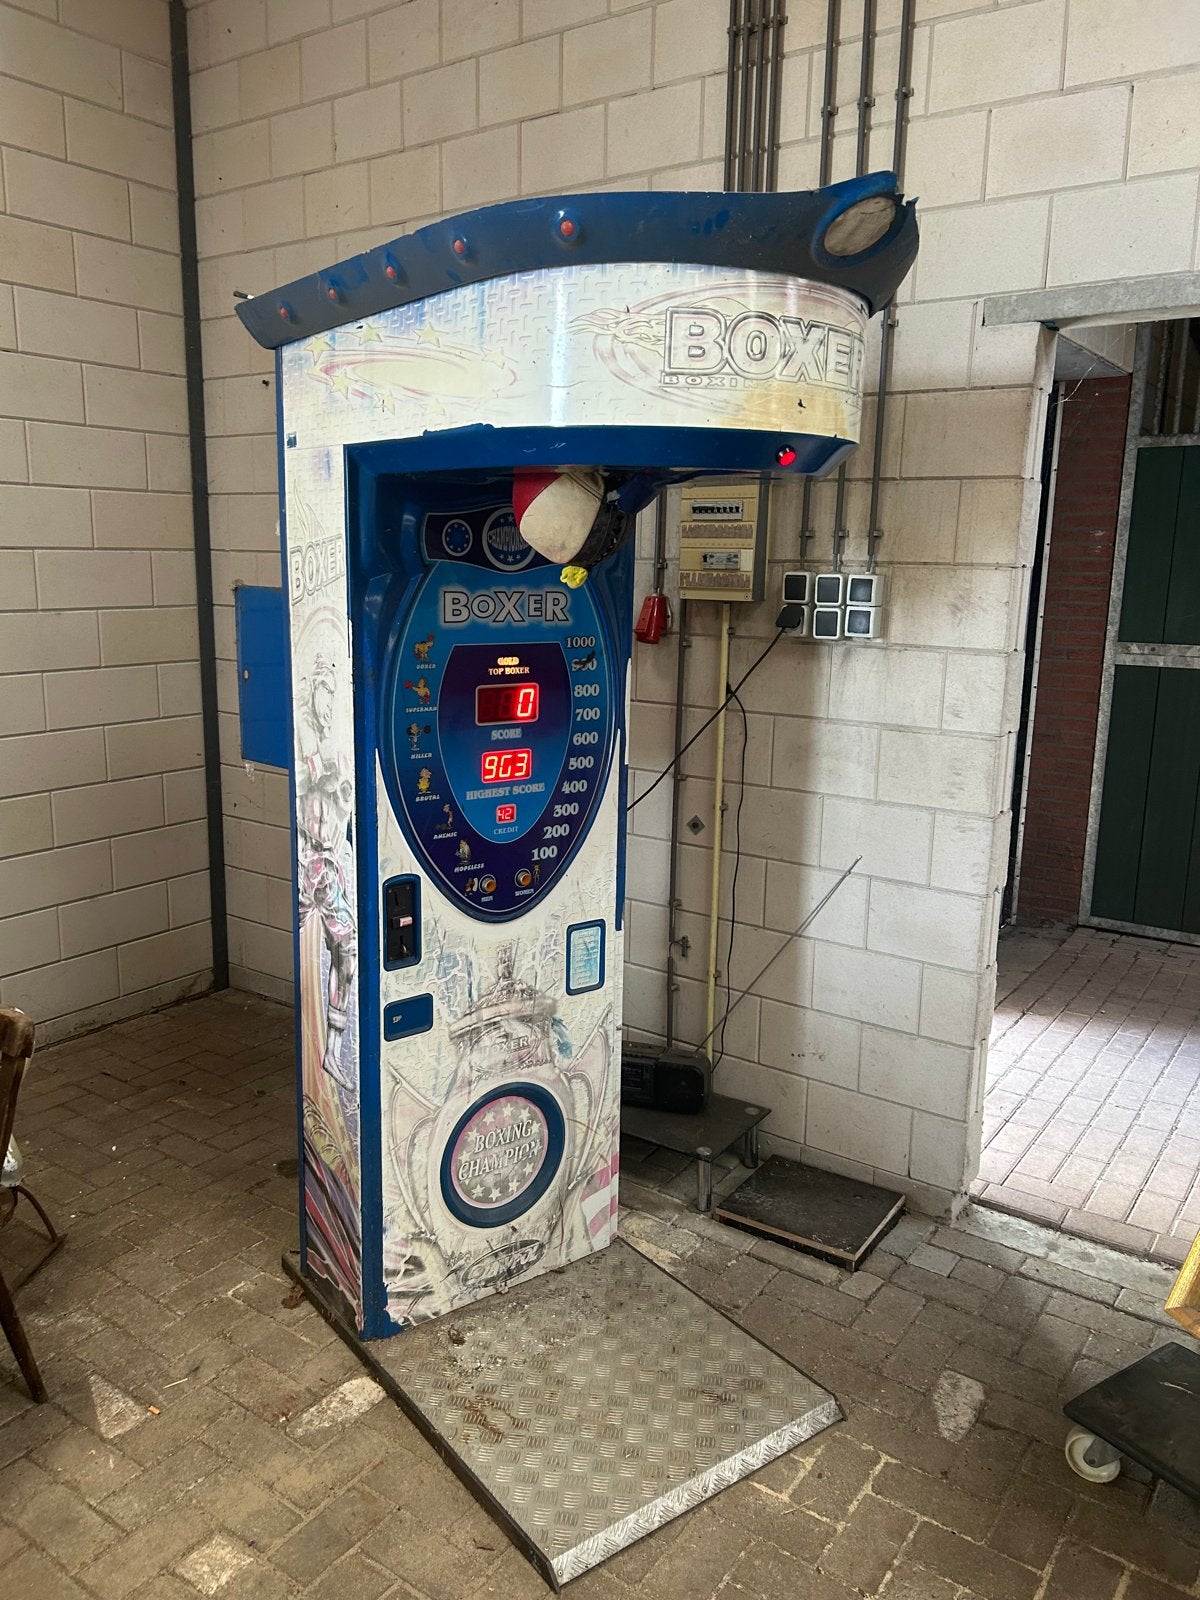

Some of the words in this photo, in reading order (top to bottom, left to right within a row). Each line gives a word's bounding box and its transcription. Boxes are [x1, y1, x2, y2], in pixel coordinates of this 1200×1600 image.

[664, 306, 864, 395] BOXER
[289, 534, 345, 606] BOXER
[443, 591, 569, 623] BOXER
[566, 636, 596, 648] 1000
[488, 667, 504, 676] TOP
[504, 666, 530, 675] BOXER
[573, 683, 600, 697] 800
[517, 688, 535, 717] 0
[575, 707, 600, 721] 700
[491, 727, 522, 740] SCORE
[572, 731, 599, 746] 600
[410, 752, 433, 760] KILLER
[568, 755, 594, 771] 500
[465, 786, 511, 801] HIGHEST
[512, 782, 546, 795] SCORE
[561, 779, 588, 794] 400
[415, 794, 440, 802] BRUTAL
[553, 802, 580, 818] 300
[493, 825, 519, 835] CREDIT
[542, 823, 570, 840] 200
[531, 845, 558, 861] 100
[454, 863, 485, 874] HOPELESS
[474, 1119, 533, 1153] BOXING
[458, 1140, 541, 1181] CHAMPION
